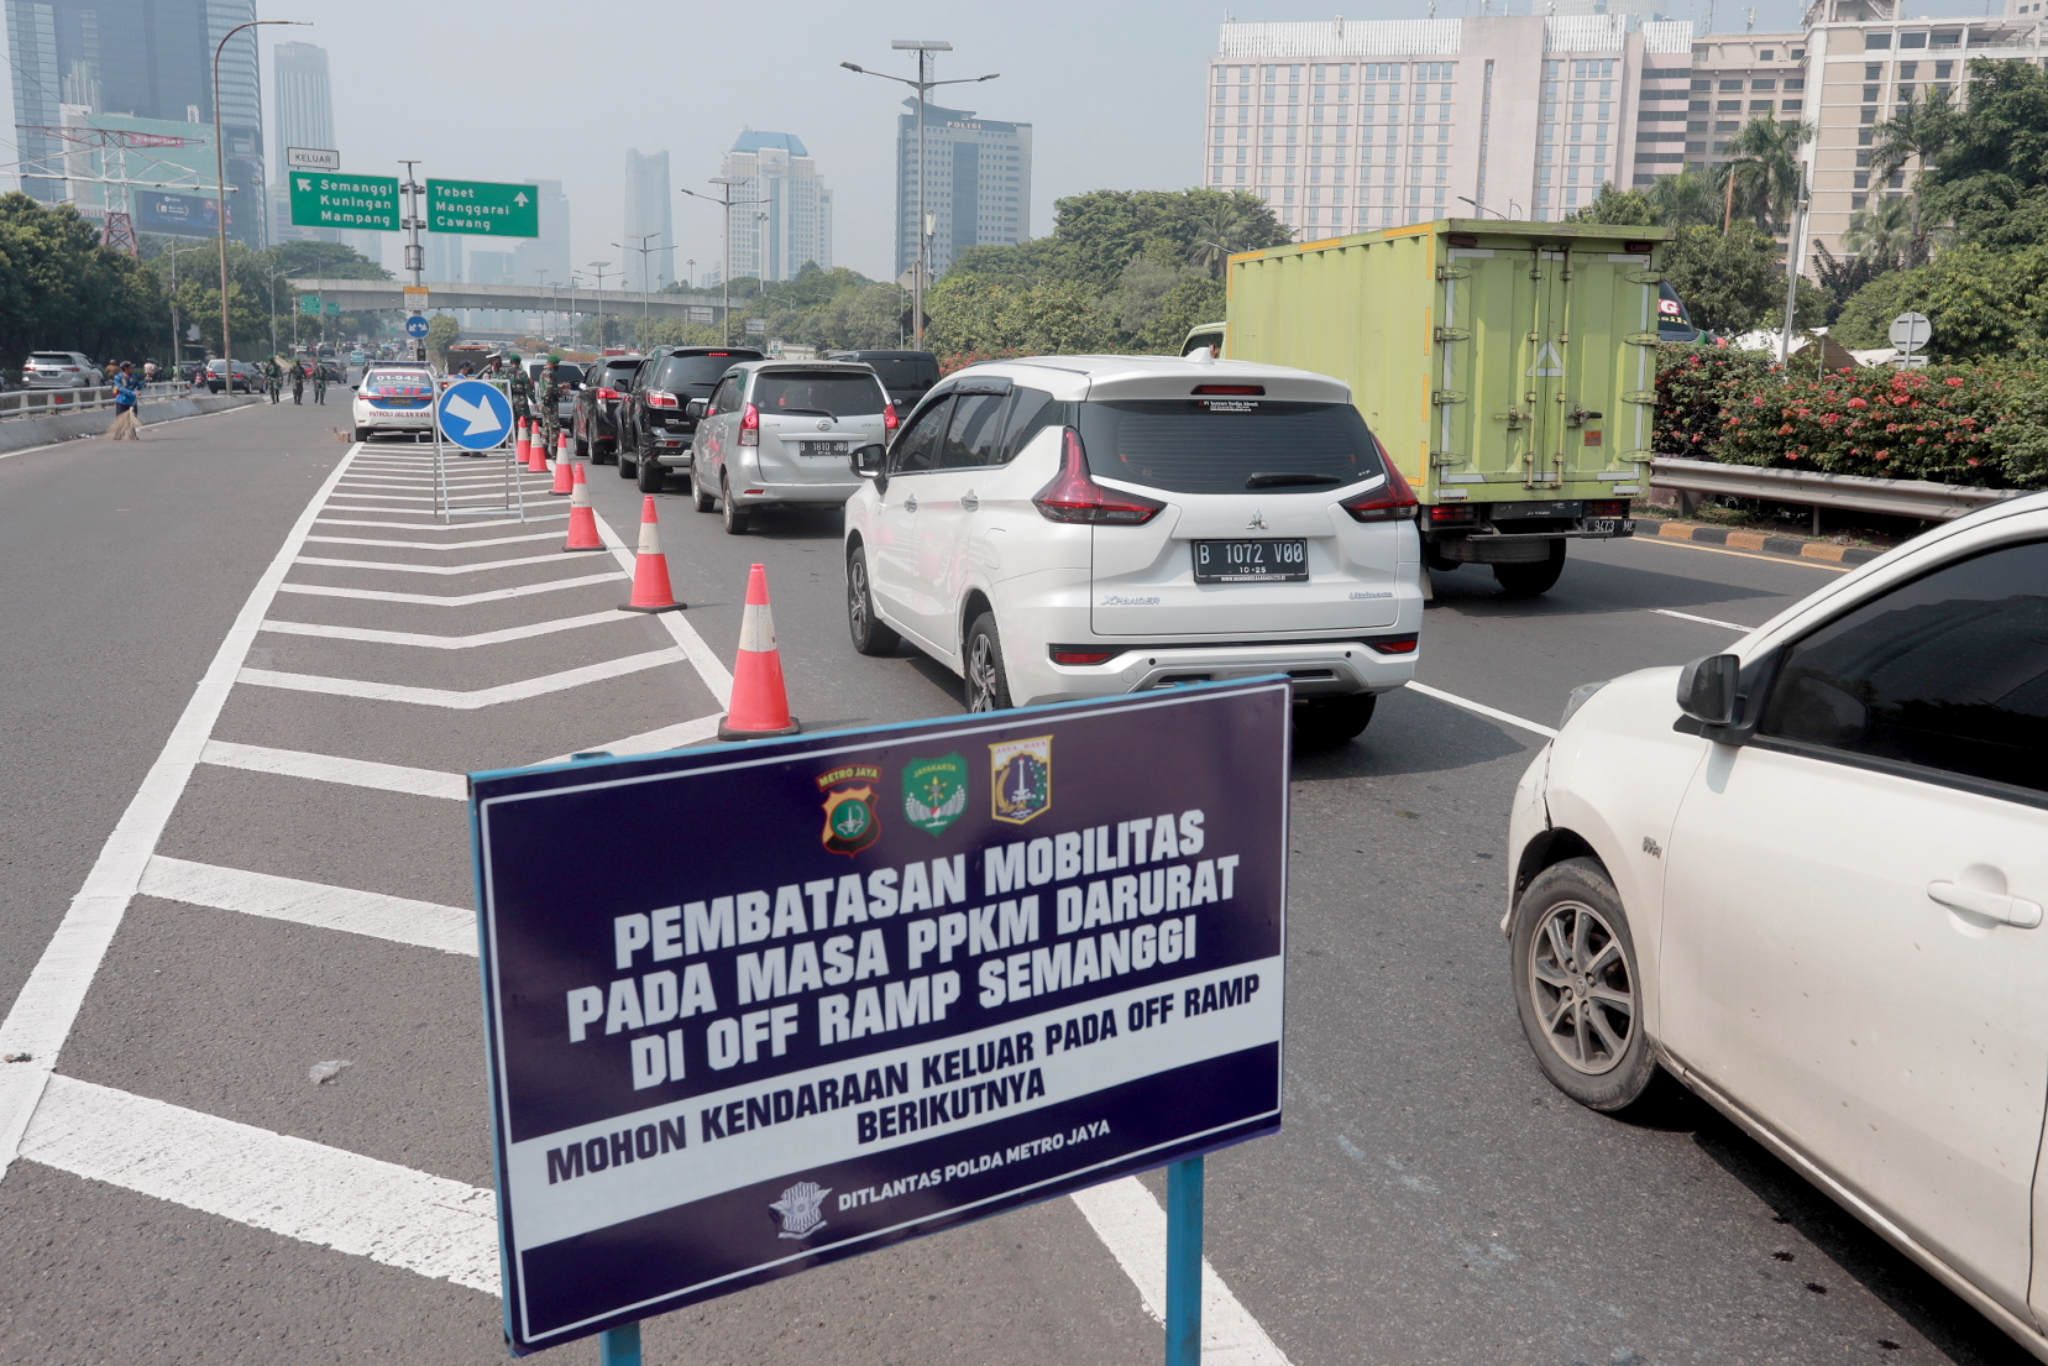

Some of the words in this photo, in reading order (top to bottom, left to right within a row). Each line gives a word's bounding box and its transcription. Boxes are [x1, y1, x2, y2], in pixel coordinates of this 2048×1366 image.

[947, 120, 981, 129] POLISI
[295, 153, 332, 163] KELUAR
[320, 179, 393, 196] Semanggi
[436, 186, 475, 198] Tebet
[320, 195, 392, 210] Kuningan
[436, 201, 510, 216] Manggarai
[321, 210, 391, 227] Mampang
[436, 216, 491, 232] Cawang
[1199, 545, 1210, 565] B
[1225, 544, 1264, 564] 1072
[819, 767, 855, 787] METRO
[855, 766, 879, 779] JAYA
[913, 763, 956, 778] JAYAKARTA
[614, 854, 965, 969] PEMBATASAN
[986, 810, 1205, 896] MOBILITAS
[568, 962, 717, 1042] PADA
[738, 929, 889, 1005] MASA
[909, 895, 1039, 970] PPKM
[1057, 855, 1239, 935] DARURAT
[632, 1030, 685, 1090] DI
[707, 1004, 798, 1070] OFF
[819, 970, 960, 1046] RAMP
[978, 915, 1196, 1009] SEMANGGI
[547, 1116, 687, 1185] MOHON
[701, 1061, 909, 1143] KENDARAAN
[922, 1031, 1034, 1089] KELUAR
[1046, 1009, 1118, 1057] PADA
[1129, 993, 1174, 1033] OFF
[1184, 973, 1260, 1019] RAMP
[857, 1067, 1046, 1145] BERIKUTNYA
[839, 1169, 942, 1211] DITLANTAS
[945, 1152, 1003, 1181] POLDA
[1006, 1133, 1064, 1164] METRO
[1067, 1119, 1110, 1145] JAYA
